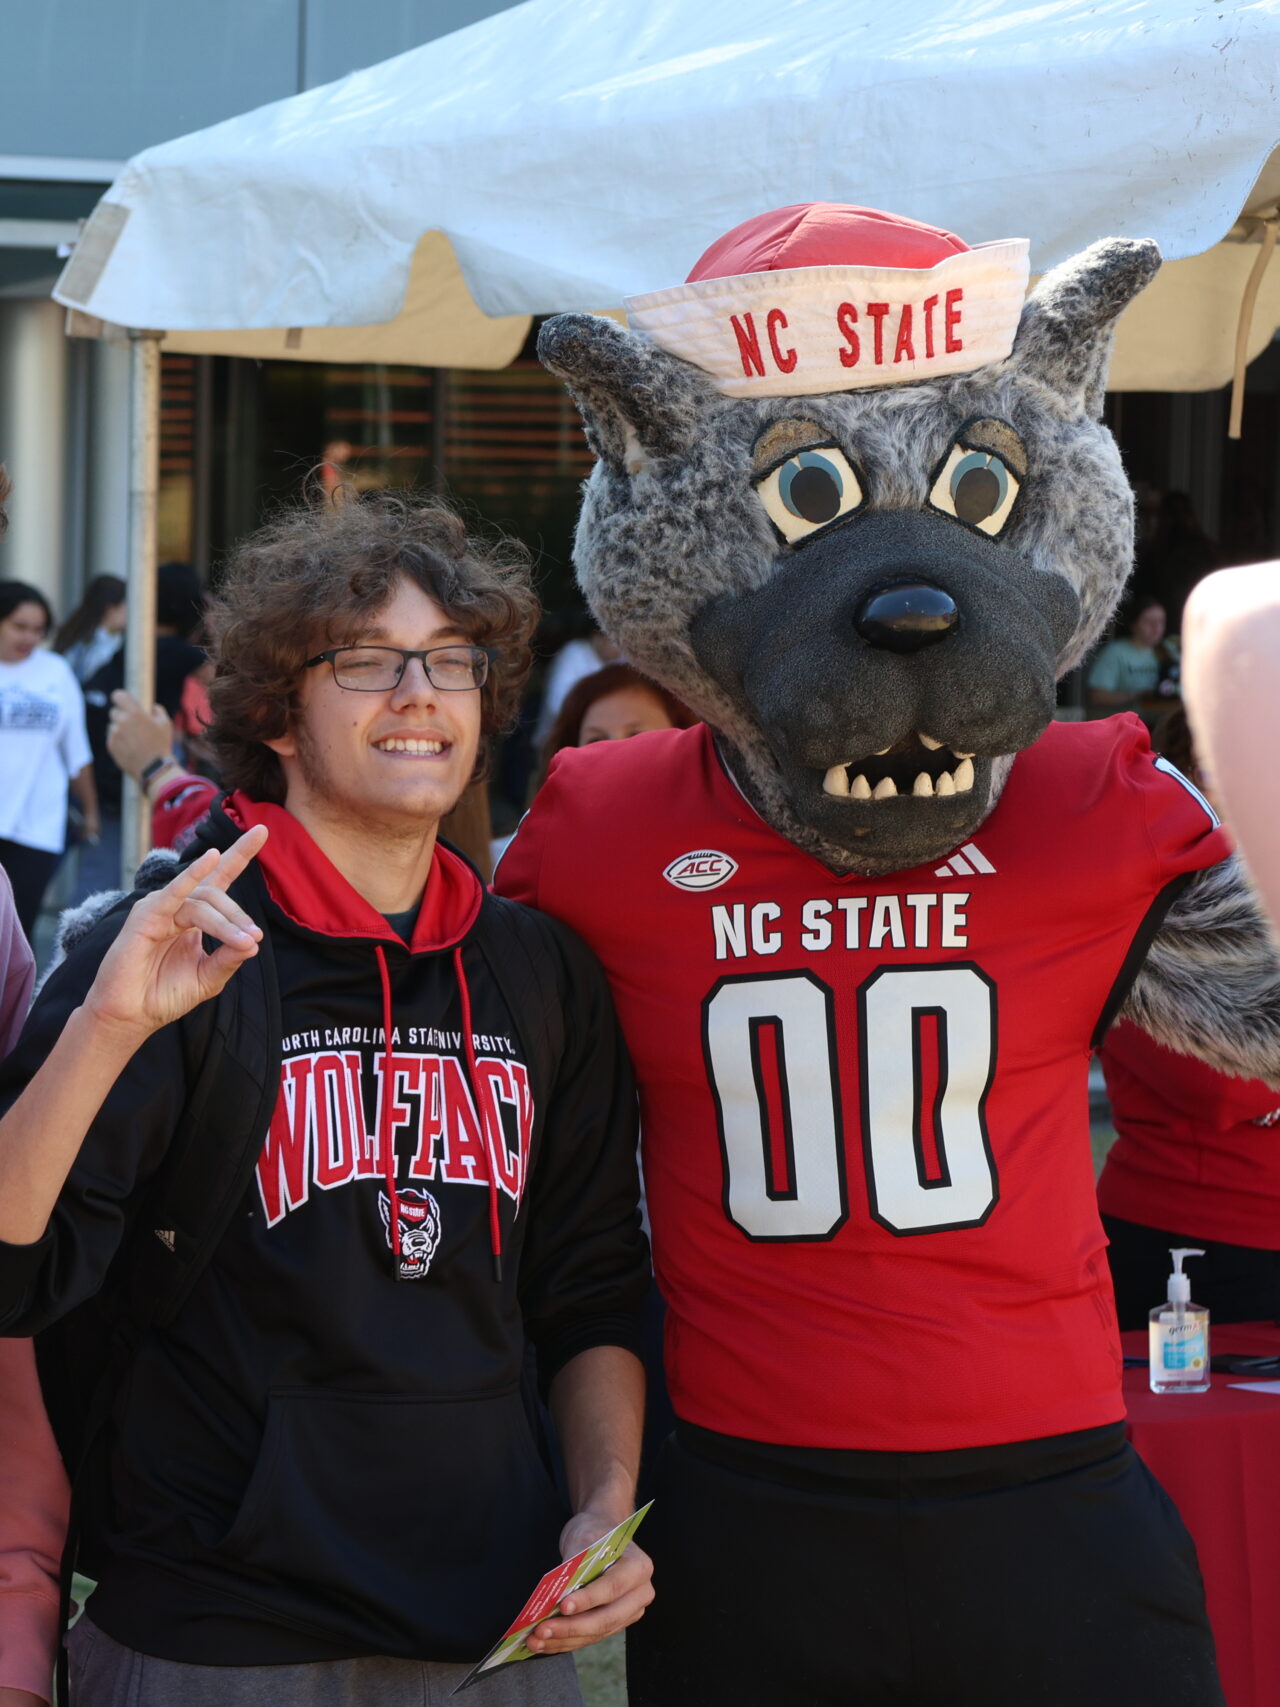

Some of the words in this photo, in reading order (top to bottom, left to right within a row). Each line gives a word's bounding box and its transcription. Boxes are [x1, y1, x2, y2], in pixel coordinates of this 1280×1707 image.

[730, 307, 798, 377] NC
[836, 287, 963, 368] STATE
[676, 858, 725, 876] ACC
[710, 902, 783, 961] NC
[800, 892, 972, 951] STATE
[282, 1028, 320, 1052] ORTH
[701, 959, 1000, 1243] 00
